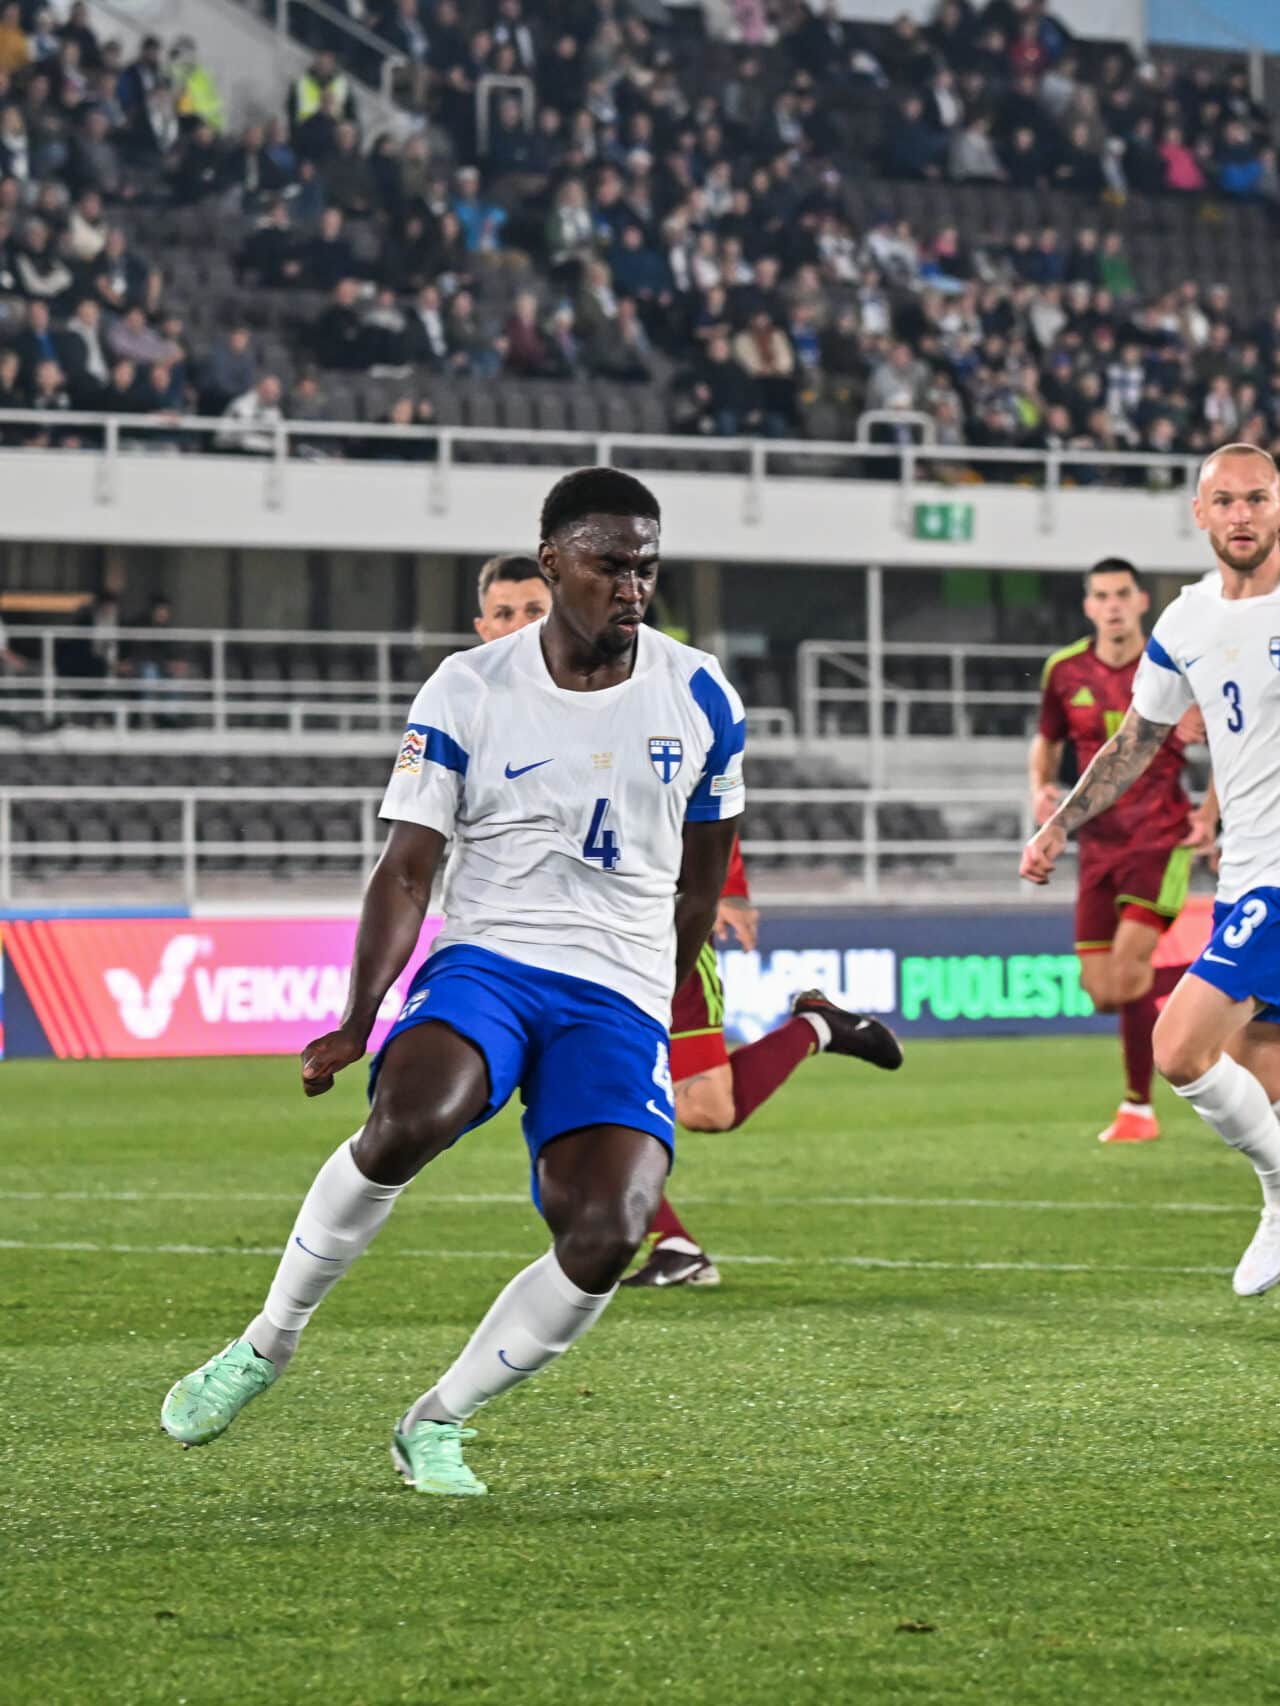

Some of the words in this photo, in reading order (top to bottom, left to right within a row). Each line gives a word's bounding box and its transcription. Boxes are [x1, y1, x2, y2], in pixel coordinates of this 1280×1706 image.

[1222, 681, 1244, 733] 3
[583, 798, 621, 871] 4
[1223, 898, 1268, 948] 3
[194, 965, 403, 1023] VEIKKAS
